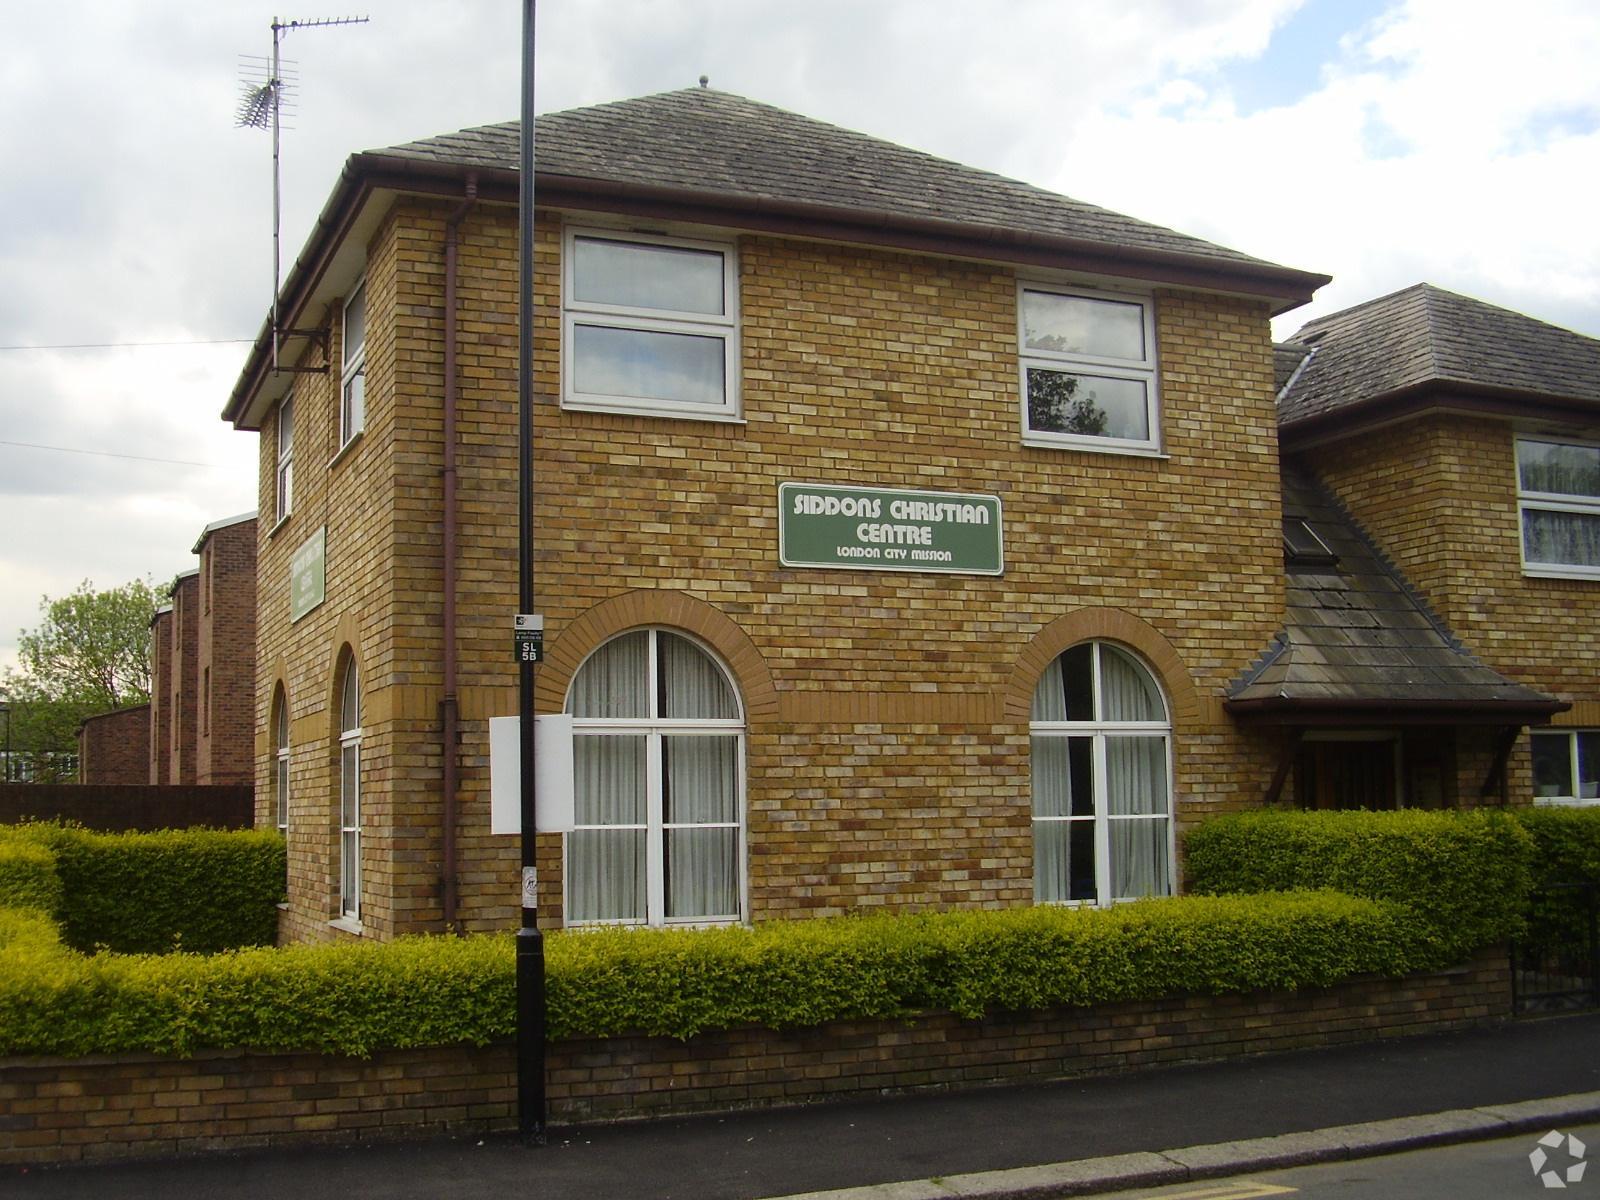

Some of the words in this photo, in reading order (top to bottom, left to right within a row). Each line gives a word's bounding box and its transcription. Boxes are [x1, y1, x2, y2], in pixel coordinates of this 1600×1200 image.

[793, 494, 881, 518] SIDDONS
[890, 500, 989, 525] CHRISTIAN
[856, 523, 932, 545] CENTRE
[836, 546, 881, 559] LONDON
[884, 548, 907, 560] CITY
[911, 550, 952, 561] MISSION
[522, 642, 537, 652] SL
[522, 652, 537, 661] 5B
